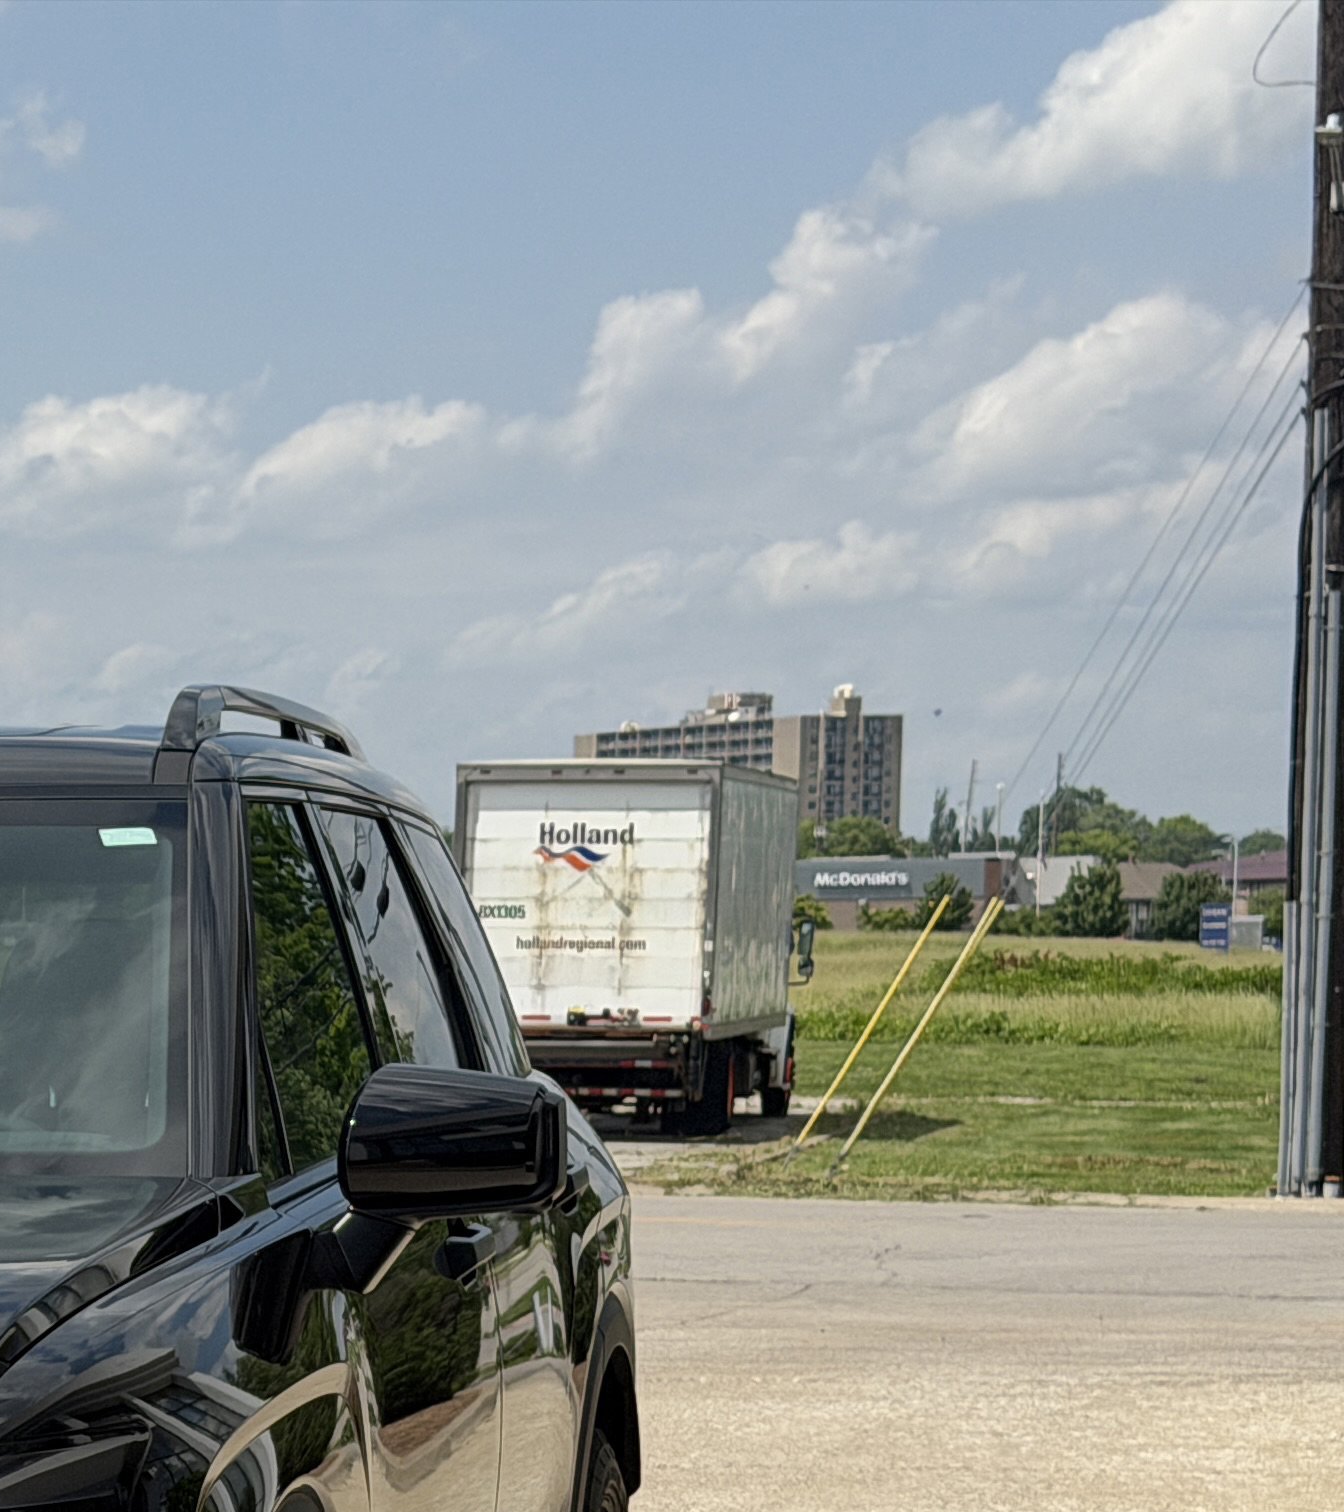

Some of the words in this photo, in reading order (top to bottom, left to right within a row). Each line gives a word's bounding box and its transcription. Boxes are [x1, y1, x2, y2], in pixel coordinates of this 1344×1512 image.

[539, 822, 635, 845] Holland
[814, 871, 909, 887] McDonald's
[516, 936, 647, 952] hollandregionalcom
